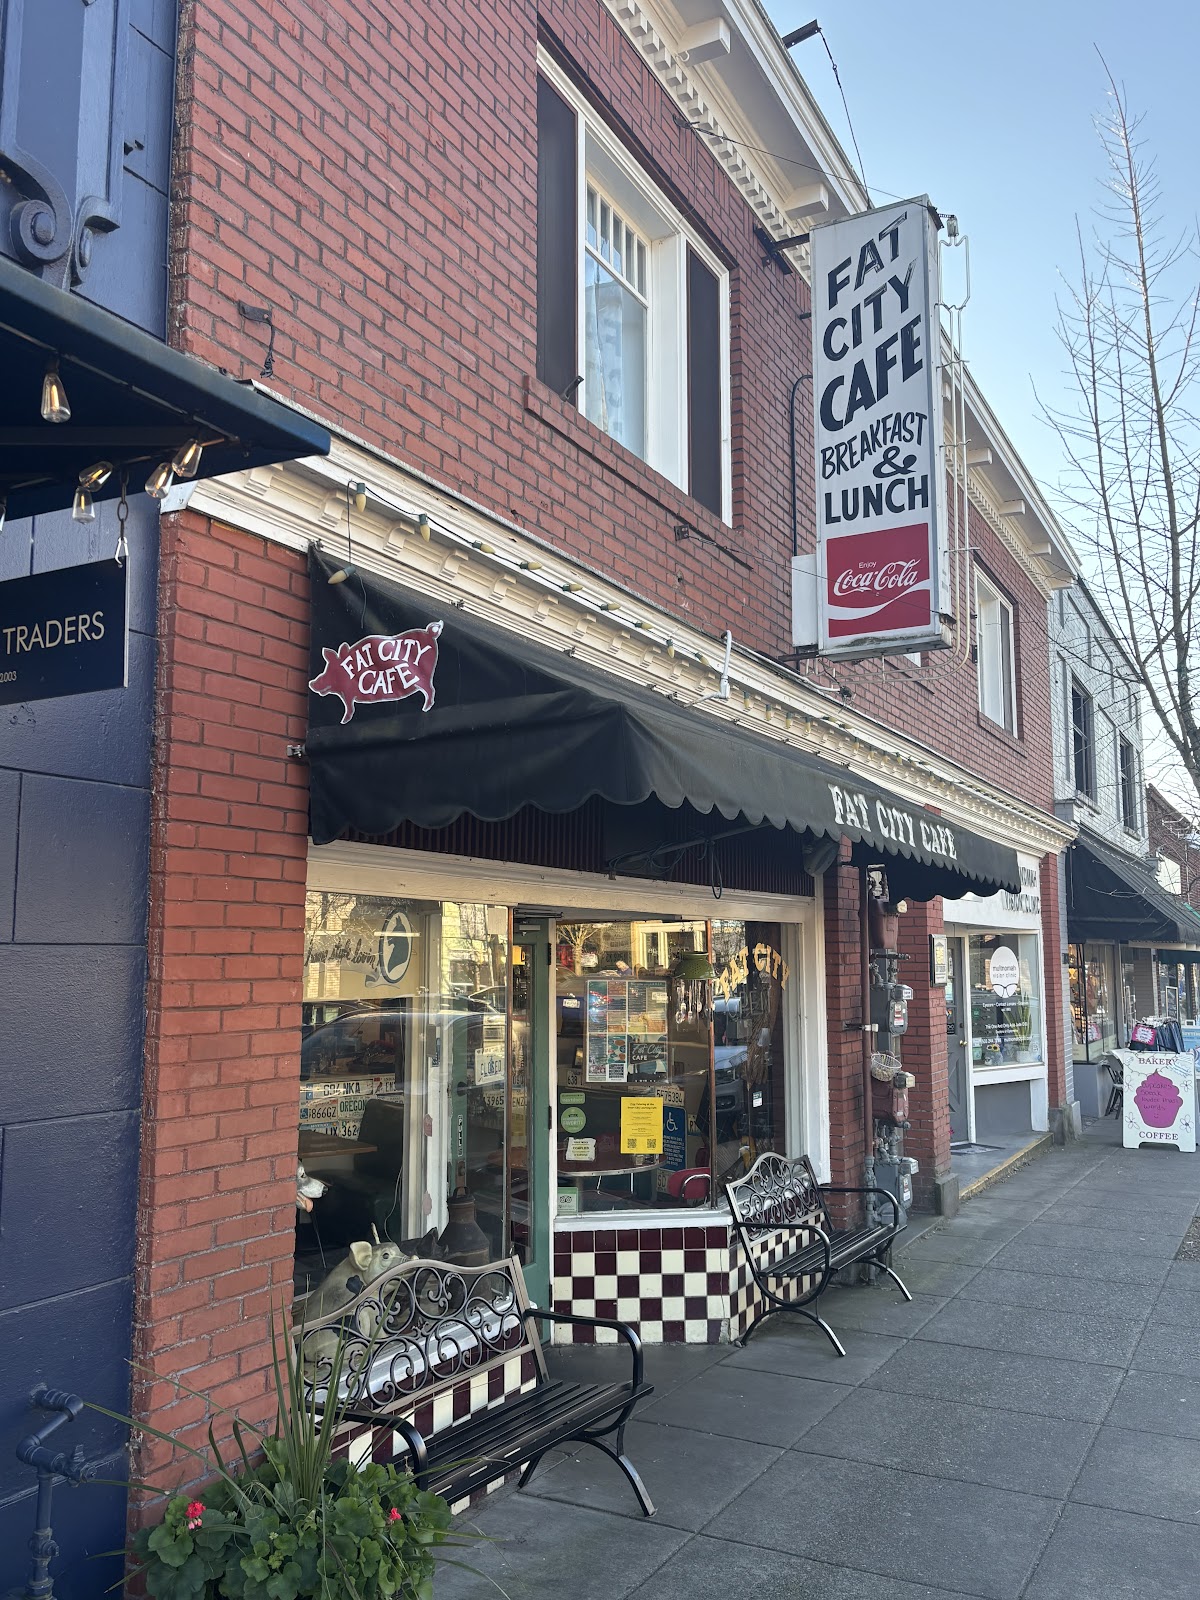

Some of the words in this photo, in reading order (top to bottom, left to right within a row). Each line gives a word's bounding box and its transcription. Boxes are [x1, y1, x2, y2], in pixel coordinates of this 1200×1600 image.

[827, 211, 907, 310] FAT
[822, 256, 918, 362] CITY
[820, 313, 923, 432] CAFE
[820, 411, 927, 480] BREAKFAST
[872, 445, 917, 479] &
[824, 474, 929, 525] LUNCH
[833, 558, 921, 597] Coca-Cola
[858, 561, 877, 570] Enjoy
[2, 611, 105, 655] TRADERS
[340, 642, 375, 680] FAT
[377, 639, 432, 666] CITY
[358, 662, 420, 695] CAFE
[828, 783, 871, 832] FAT
[876, 799, 916, 848] CITY
[919, 819, 957, 860] CAFE
[720, 945, 750, 1002] FAT
[754, 942, 790, 991] CITY
[1138, 1057, 1178, 1066] BAKERY
[1138, 1130, 1179, 1141] COFFEE
